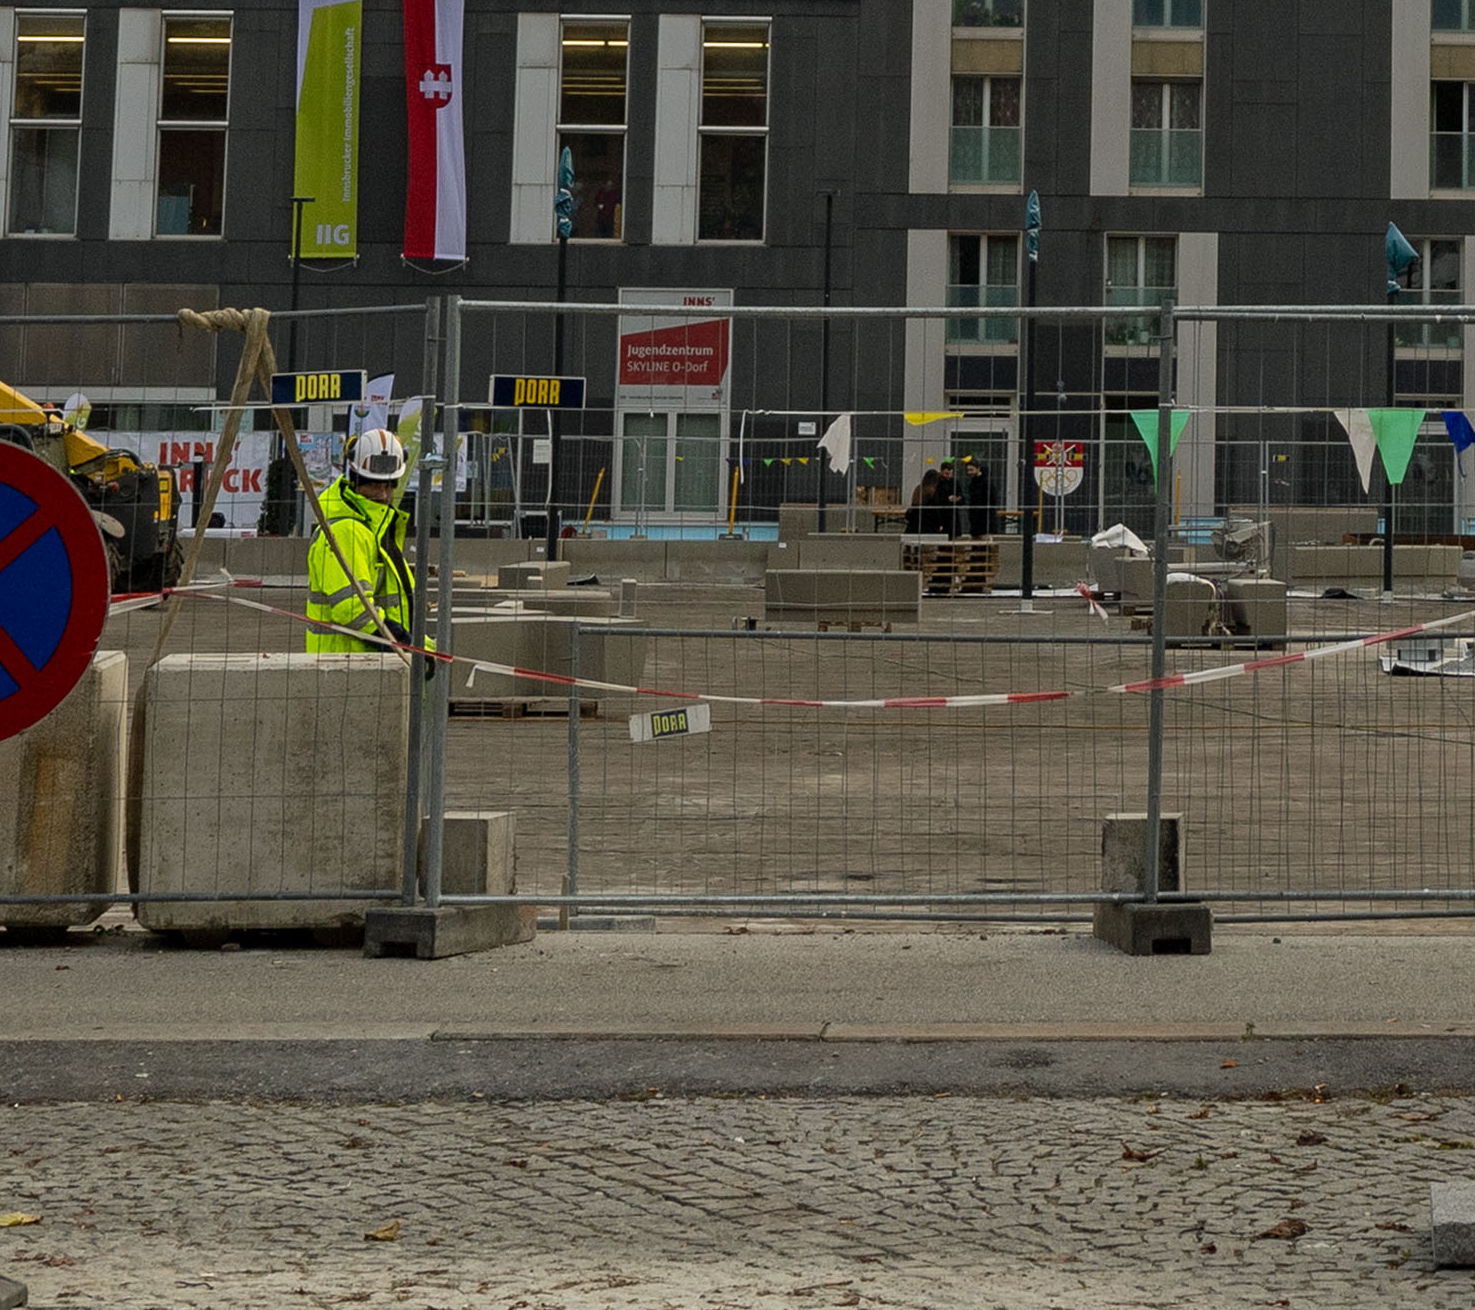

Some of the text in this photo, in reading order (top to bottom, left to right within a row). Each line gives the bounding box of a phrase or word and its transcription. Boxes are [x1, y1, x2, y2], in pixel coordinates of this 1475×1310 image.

[341, 27, 356, 202] Innsbrucker Immobiliengesellschaft
[316, 224, 350, 245] IIG
[627, 343, 714, 358] Jugendzentrum
[627, 360, 708, 373] SKYLINE O-Dorf
[295, 373, 341, 402] PORR
[514, 378, 561, 406] PORR
[652, 712, 687, 736] PORR
